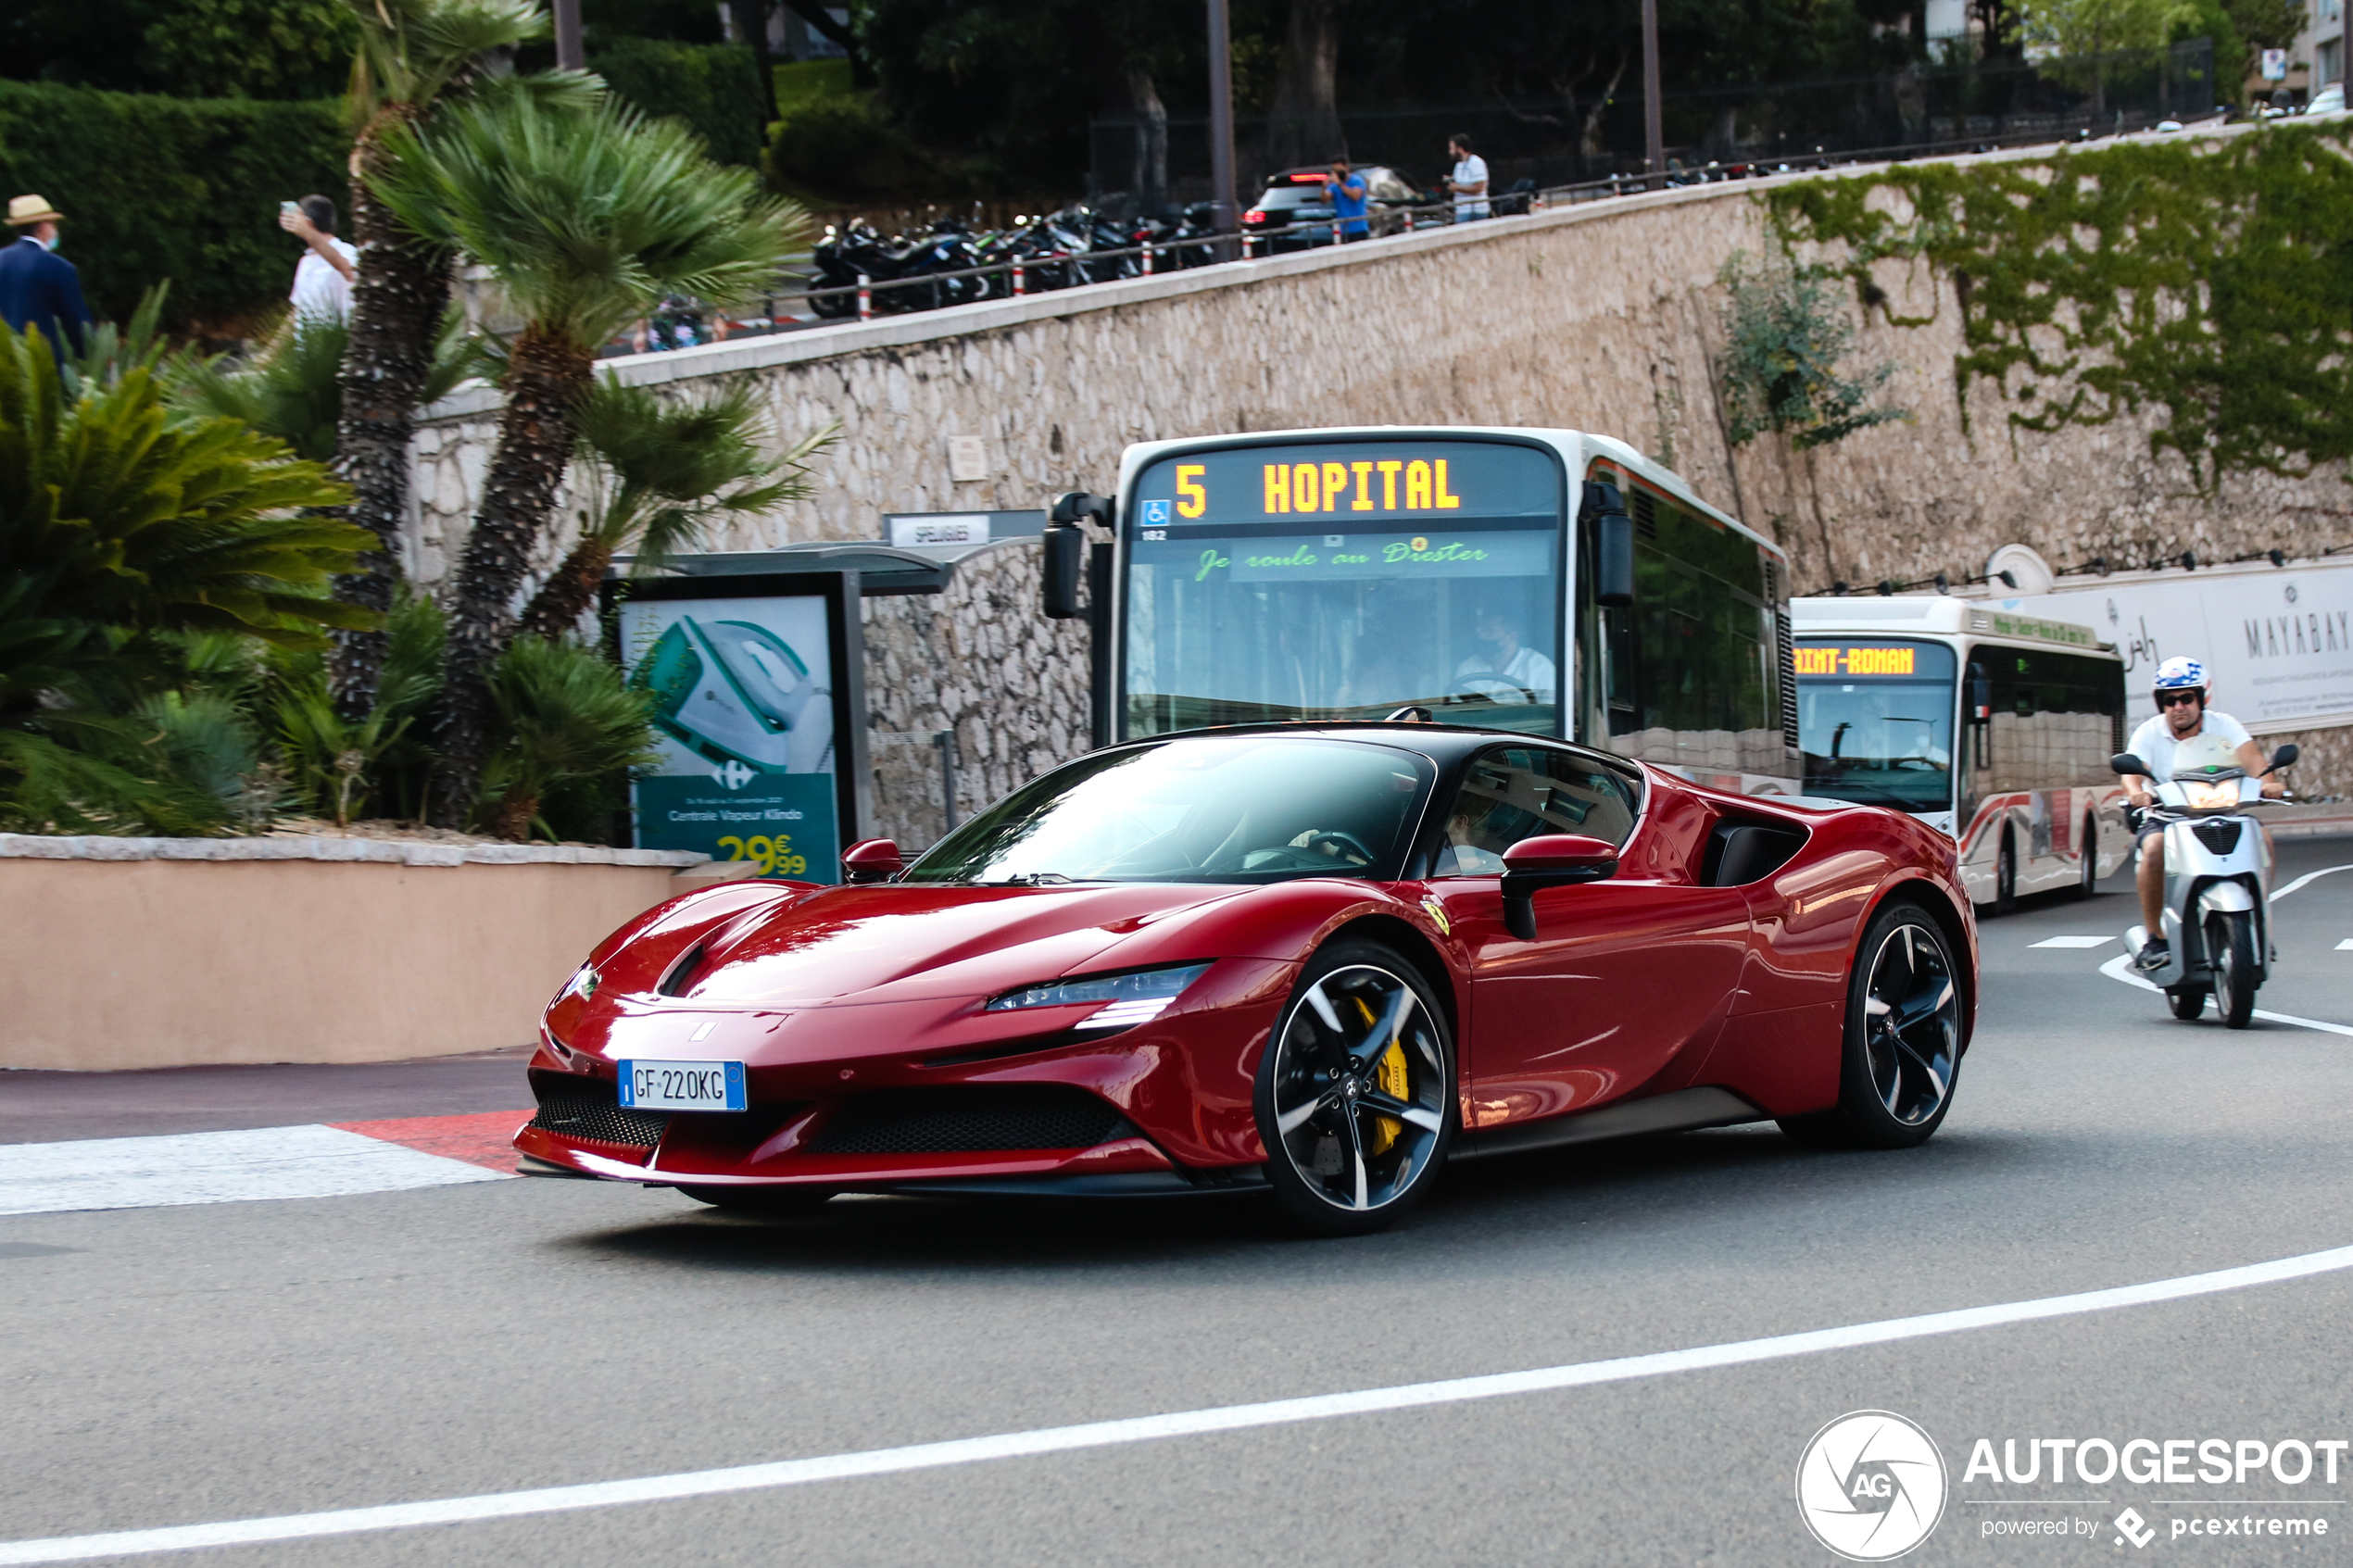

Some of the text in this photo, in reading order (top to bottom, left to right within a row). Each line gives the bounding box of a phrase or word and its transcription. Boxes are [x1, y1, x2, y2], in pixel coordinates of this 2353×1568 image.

[1176, 458, 1460, 519] 5 HOPITAL
[1140, 530, 1167, 541] 182
[1195, 539, 1489, 582] Je roule au Diester
[2244, 610, 2349, 659] MAYABAY
[668, 808, 804, 823] Centrale Vapeur Klindo
[635, 1069, 724, 1099] GF 220KG
